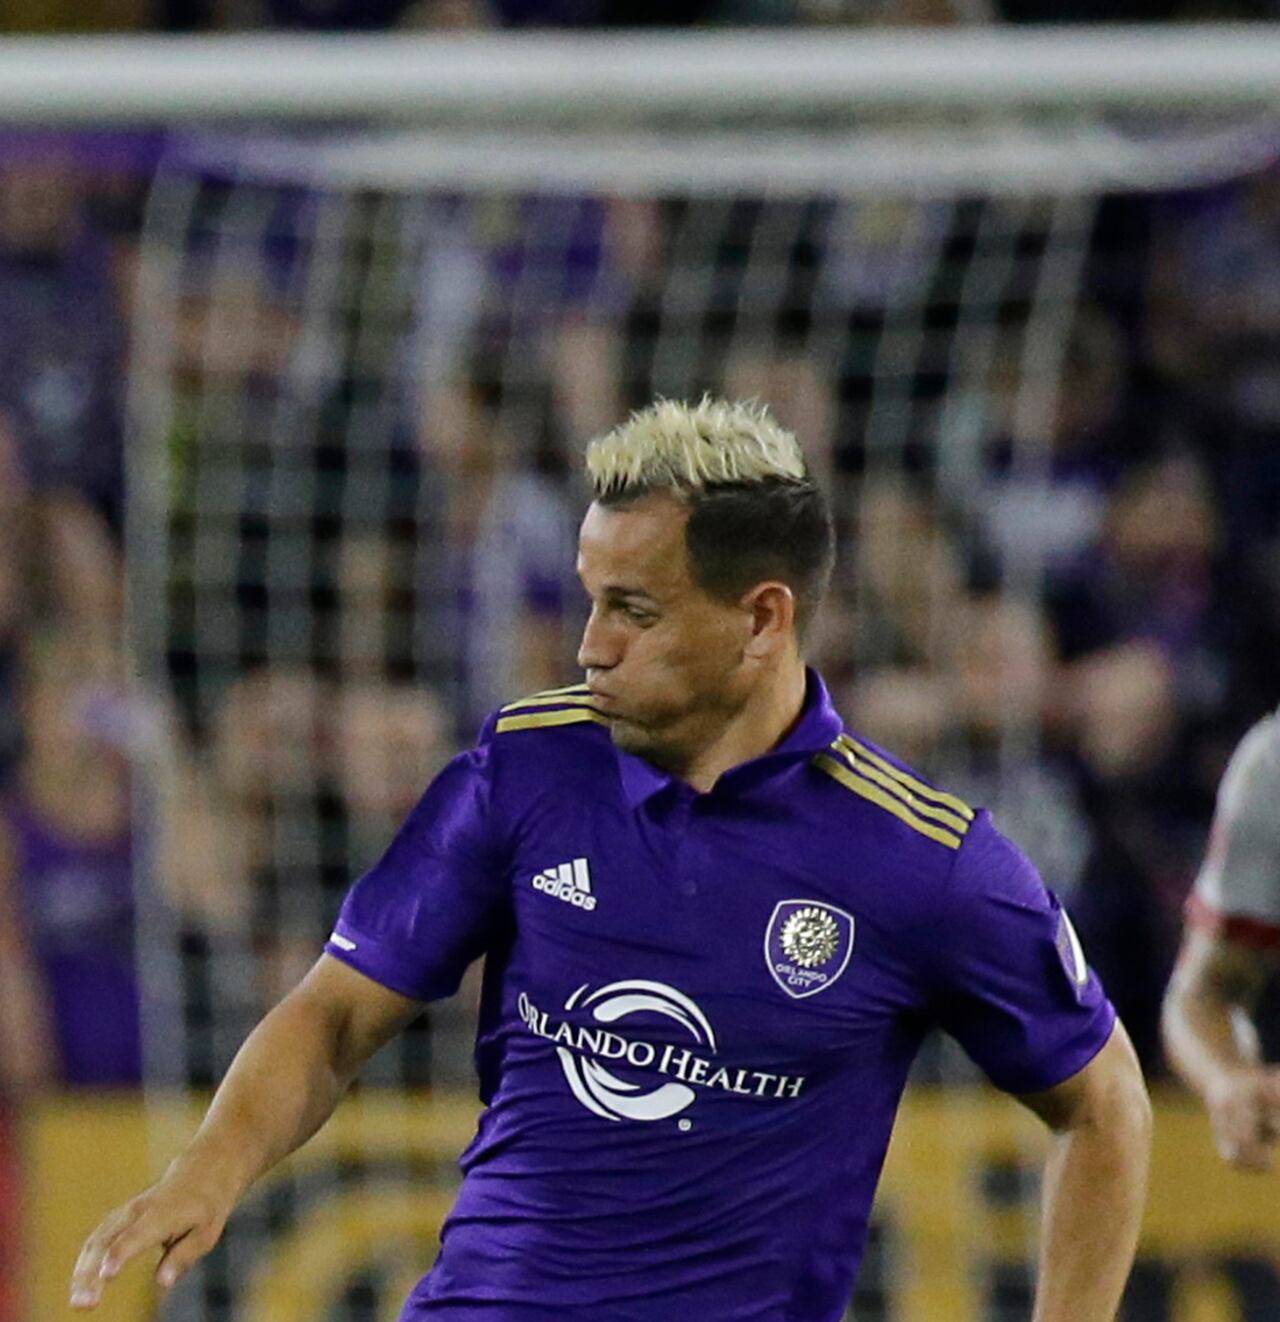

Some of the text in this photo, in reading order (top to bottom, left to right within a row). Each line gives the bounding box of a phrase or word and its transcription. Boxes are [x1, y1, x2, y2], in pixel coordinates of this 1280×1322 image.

[531, 874, 597, 911] adidas
[775, 963, 827, 983] ORLANDO
[787, 976, 811, 988] CITY
[517, 991, 806, 1099] ORLANDO HEALTH
